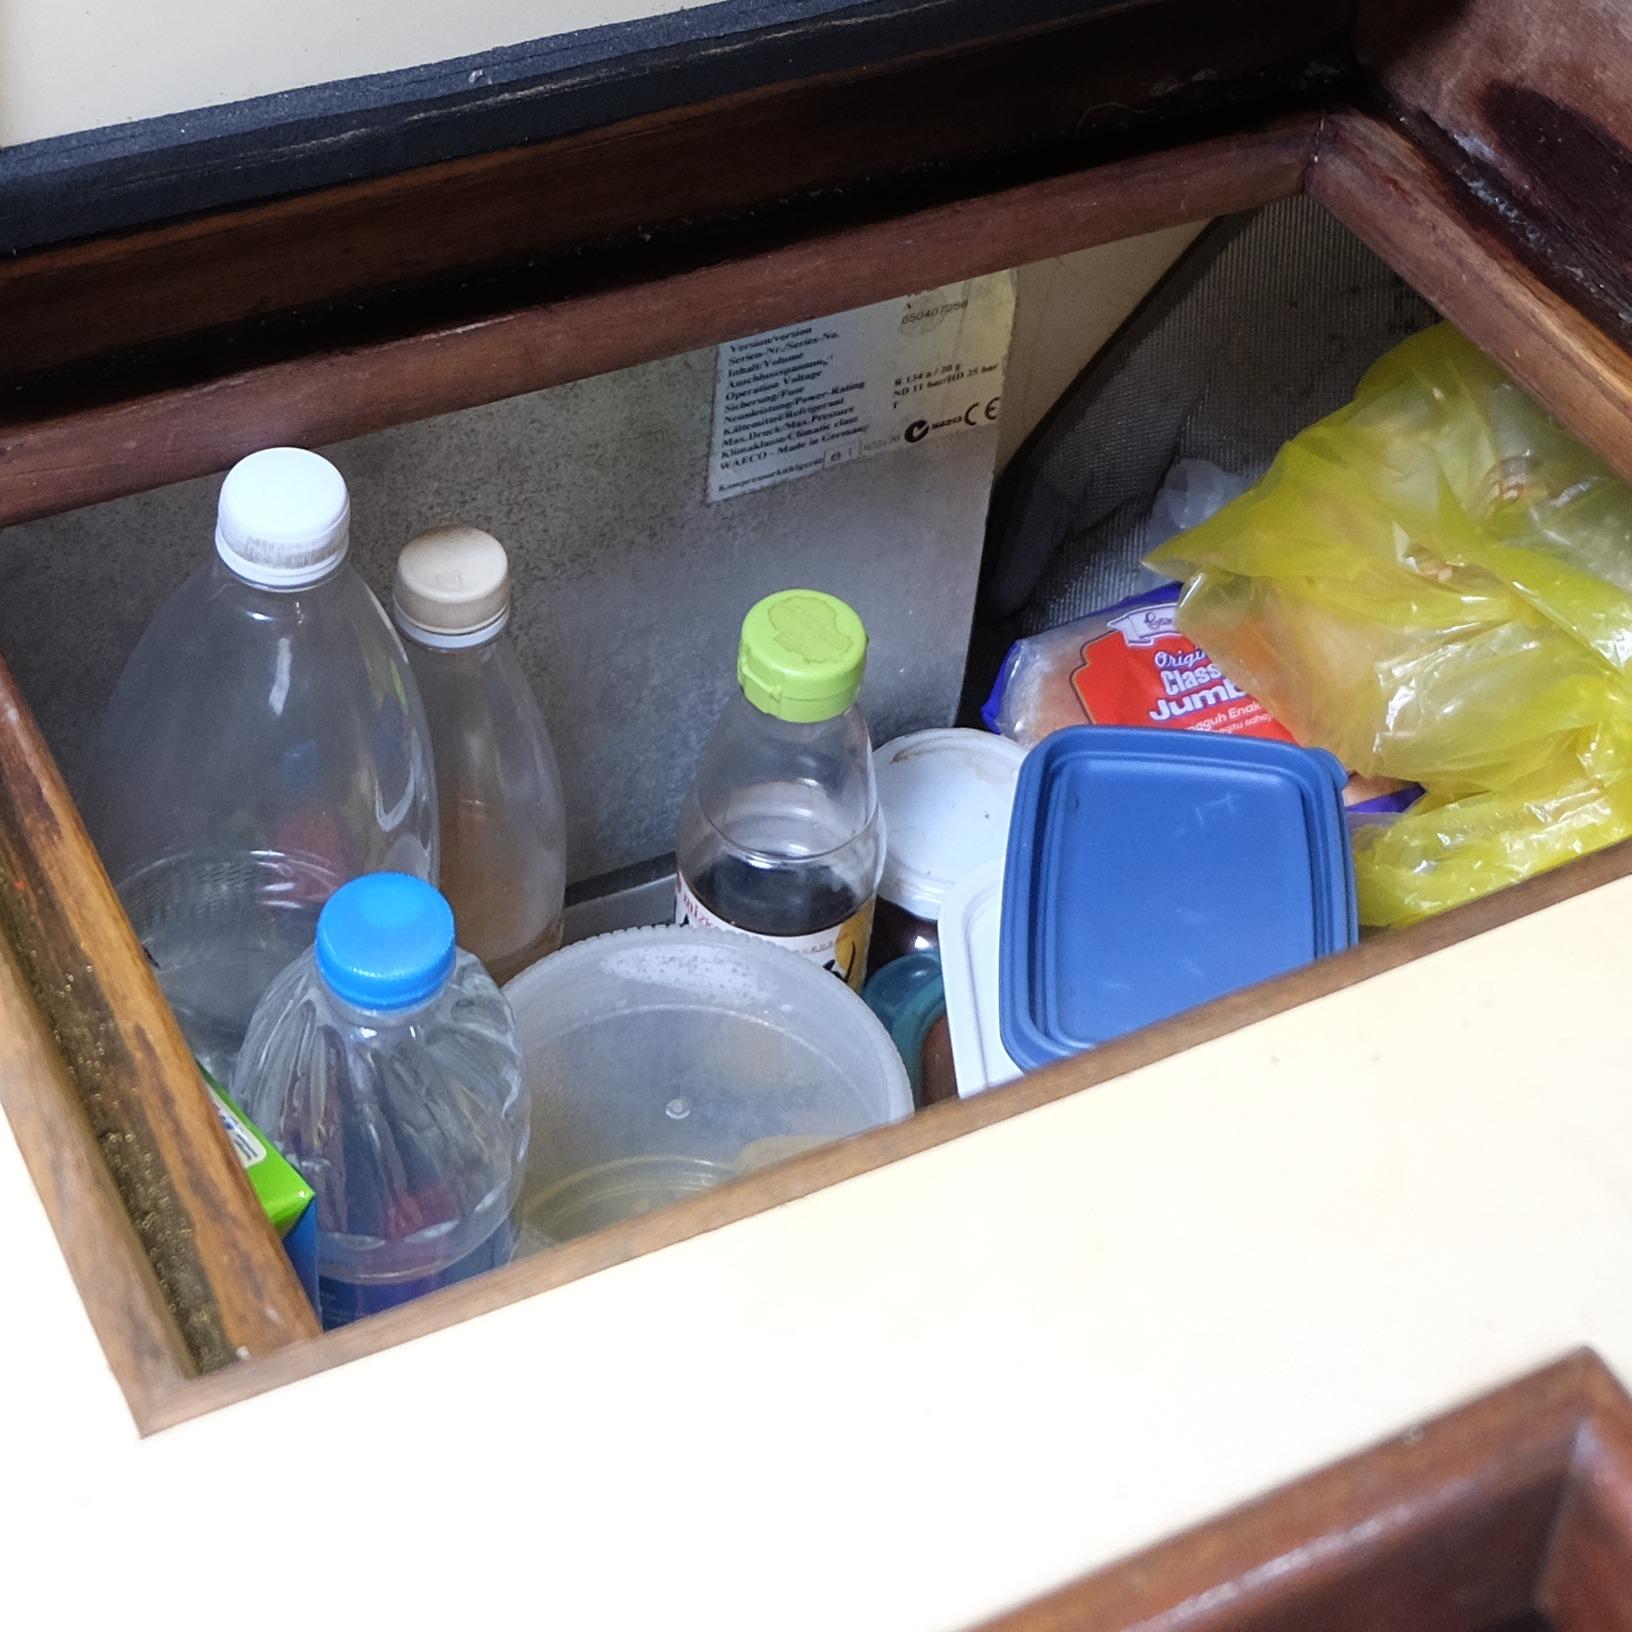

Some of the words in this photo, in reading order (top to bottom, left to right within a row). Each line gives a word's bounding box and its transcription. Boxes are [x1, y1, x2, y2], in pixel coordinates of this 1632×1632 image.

[720, 451, 768, 470] WAECO
[776, 441, 807, 455] Made
[808, 437, 819, 447] in
[821, 424, 870, 444] Germany
